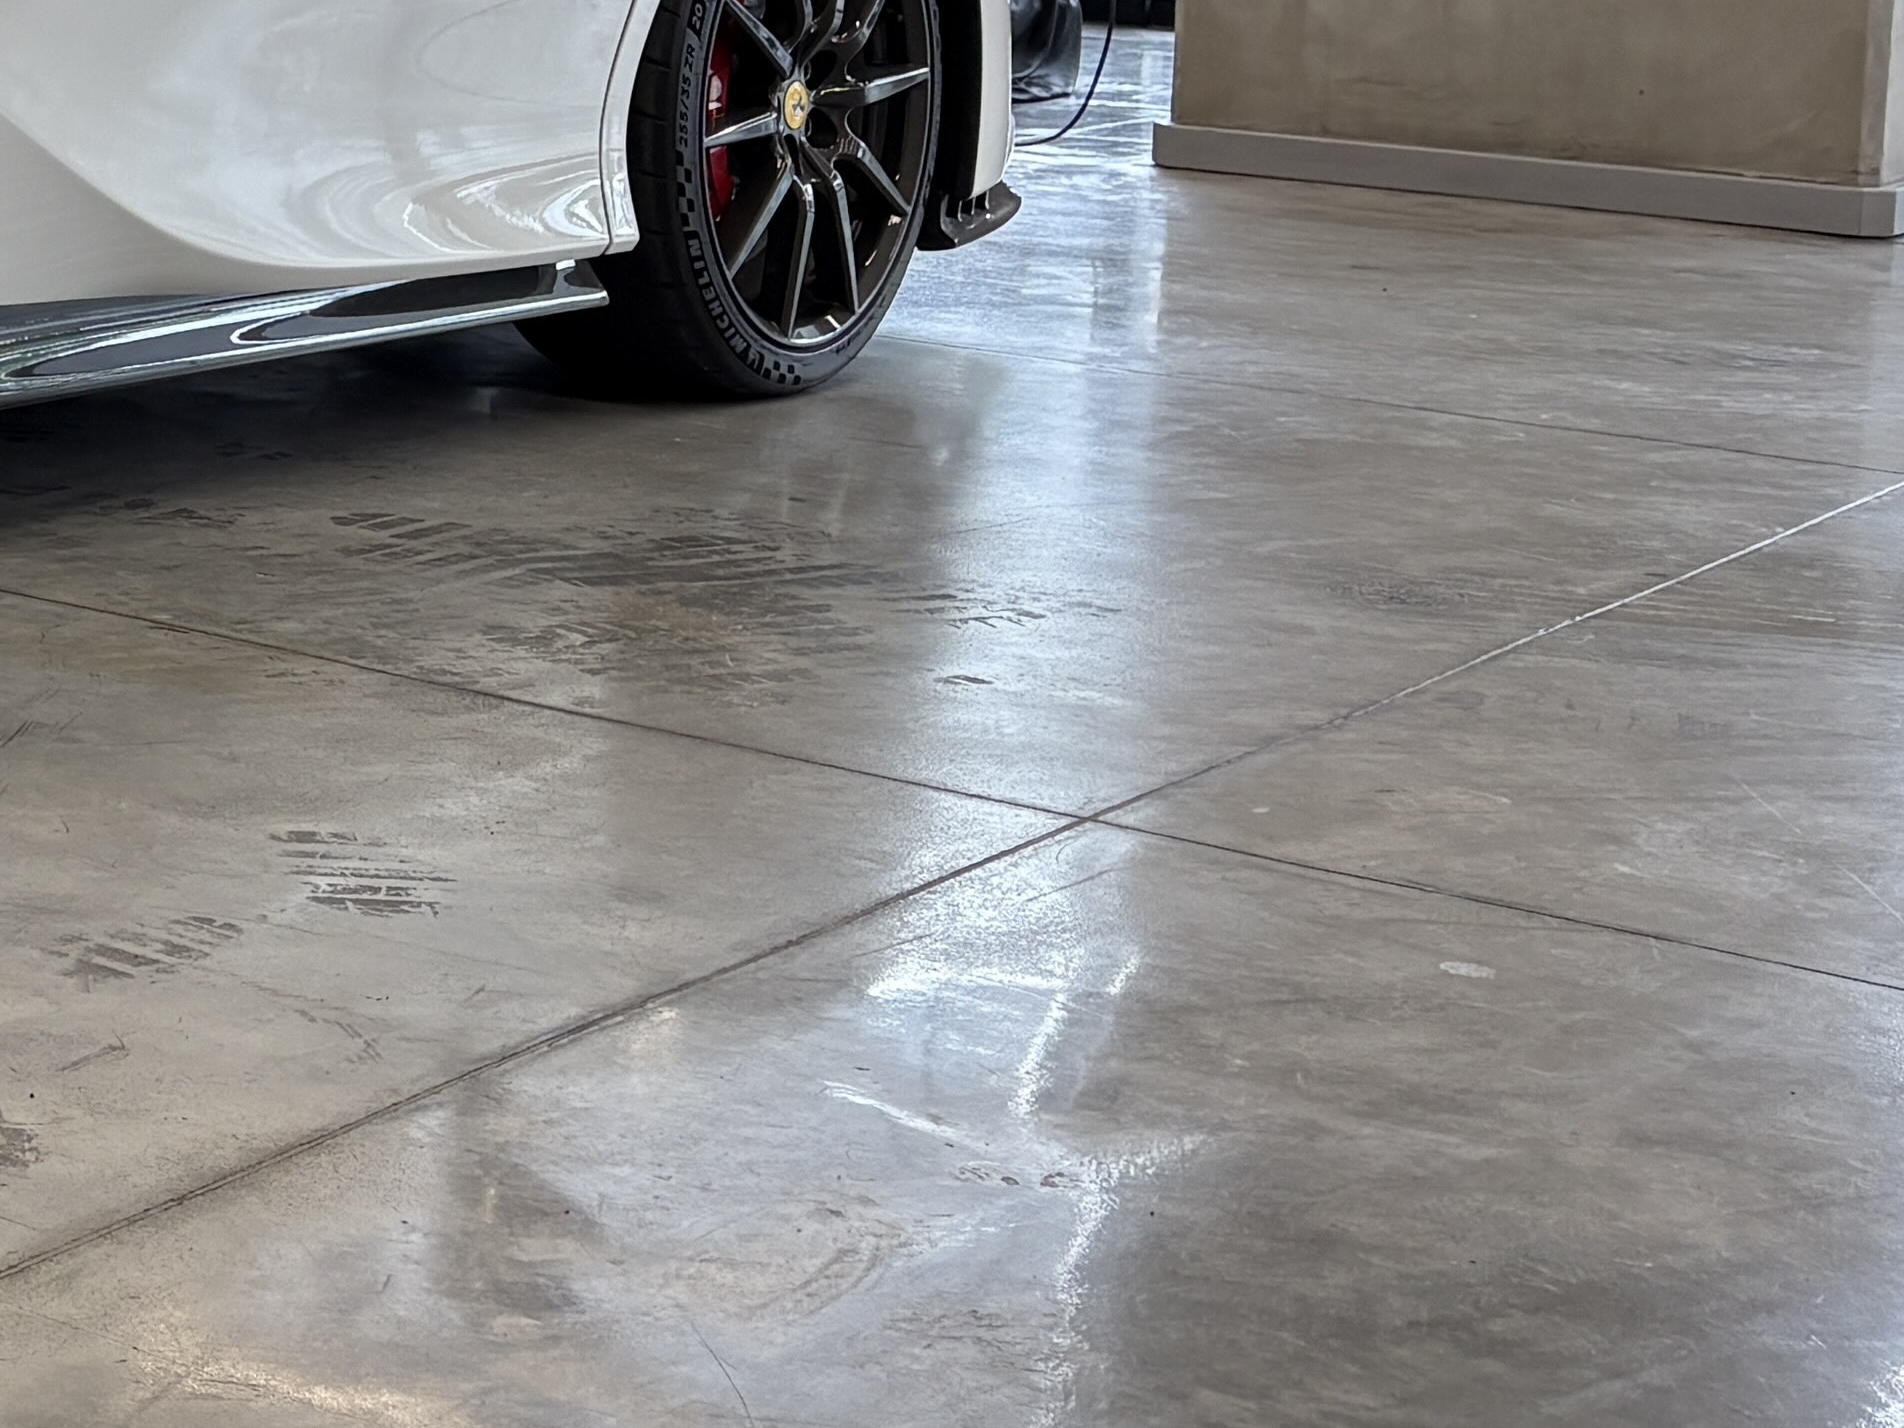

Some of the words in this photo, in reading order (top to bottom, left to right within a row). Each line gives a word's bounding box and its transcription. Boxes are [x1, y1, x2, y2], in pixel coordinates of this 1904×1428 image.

[679, 75, 690, 148] 255/35
[686, 44, 695, 69] ZR
[692, 3, 703, 30] 20
[688, 238, 748, 353] MICHELIN
